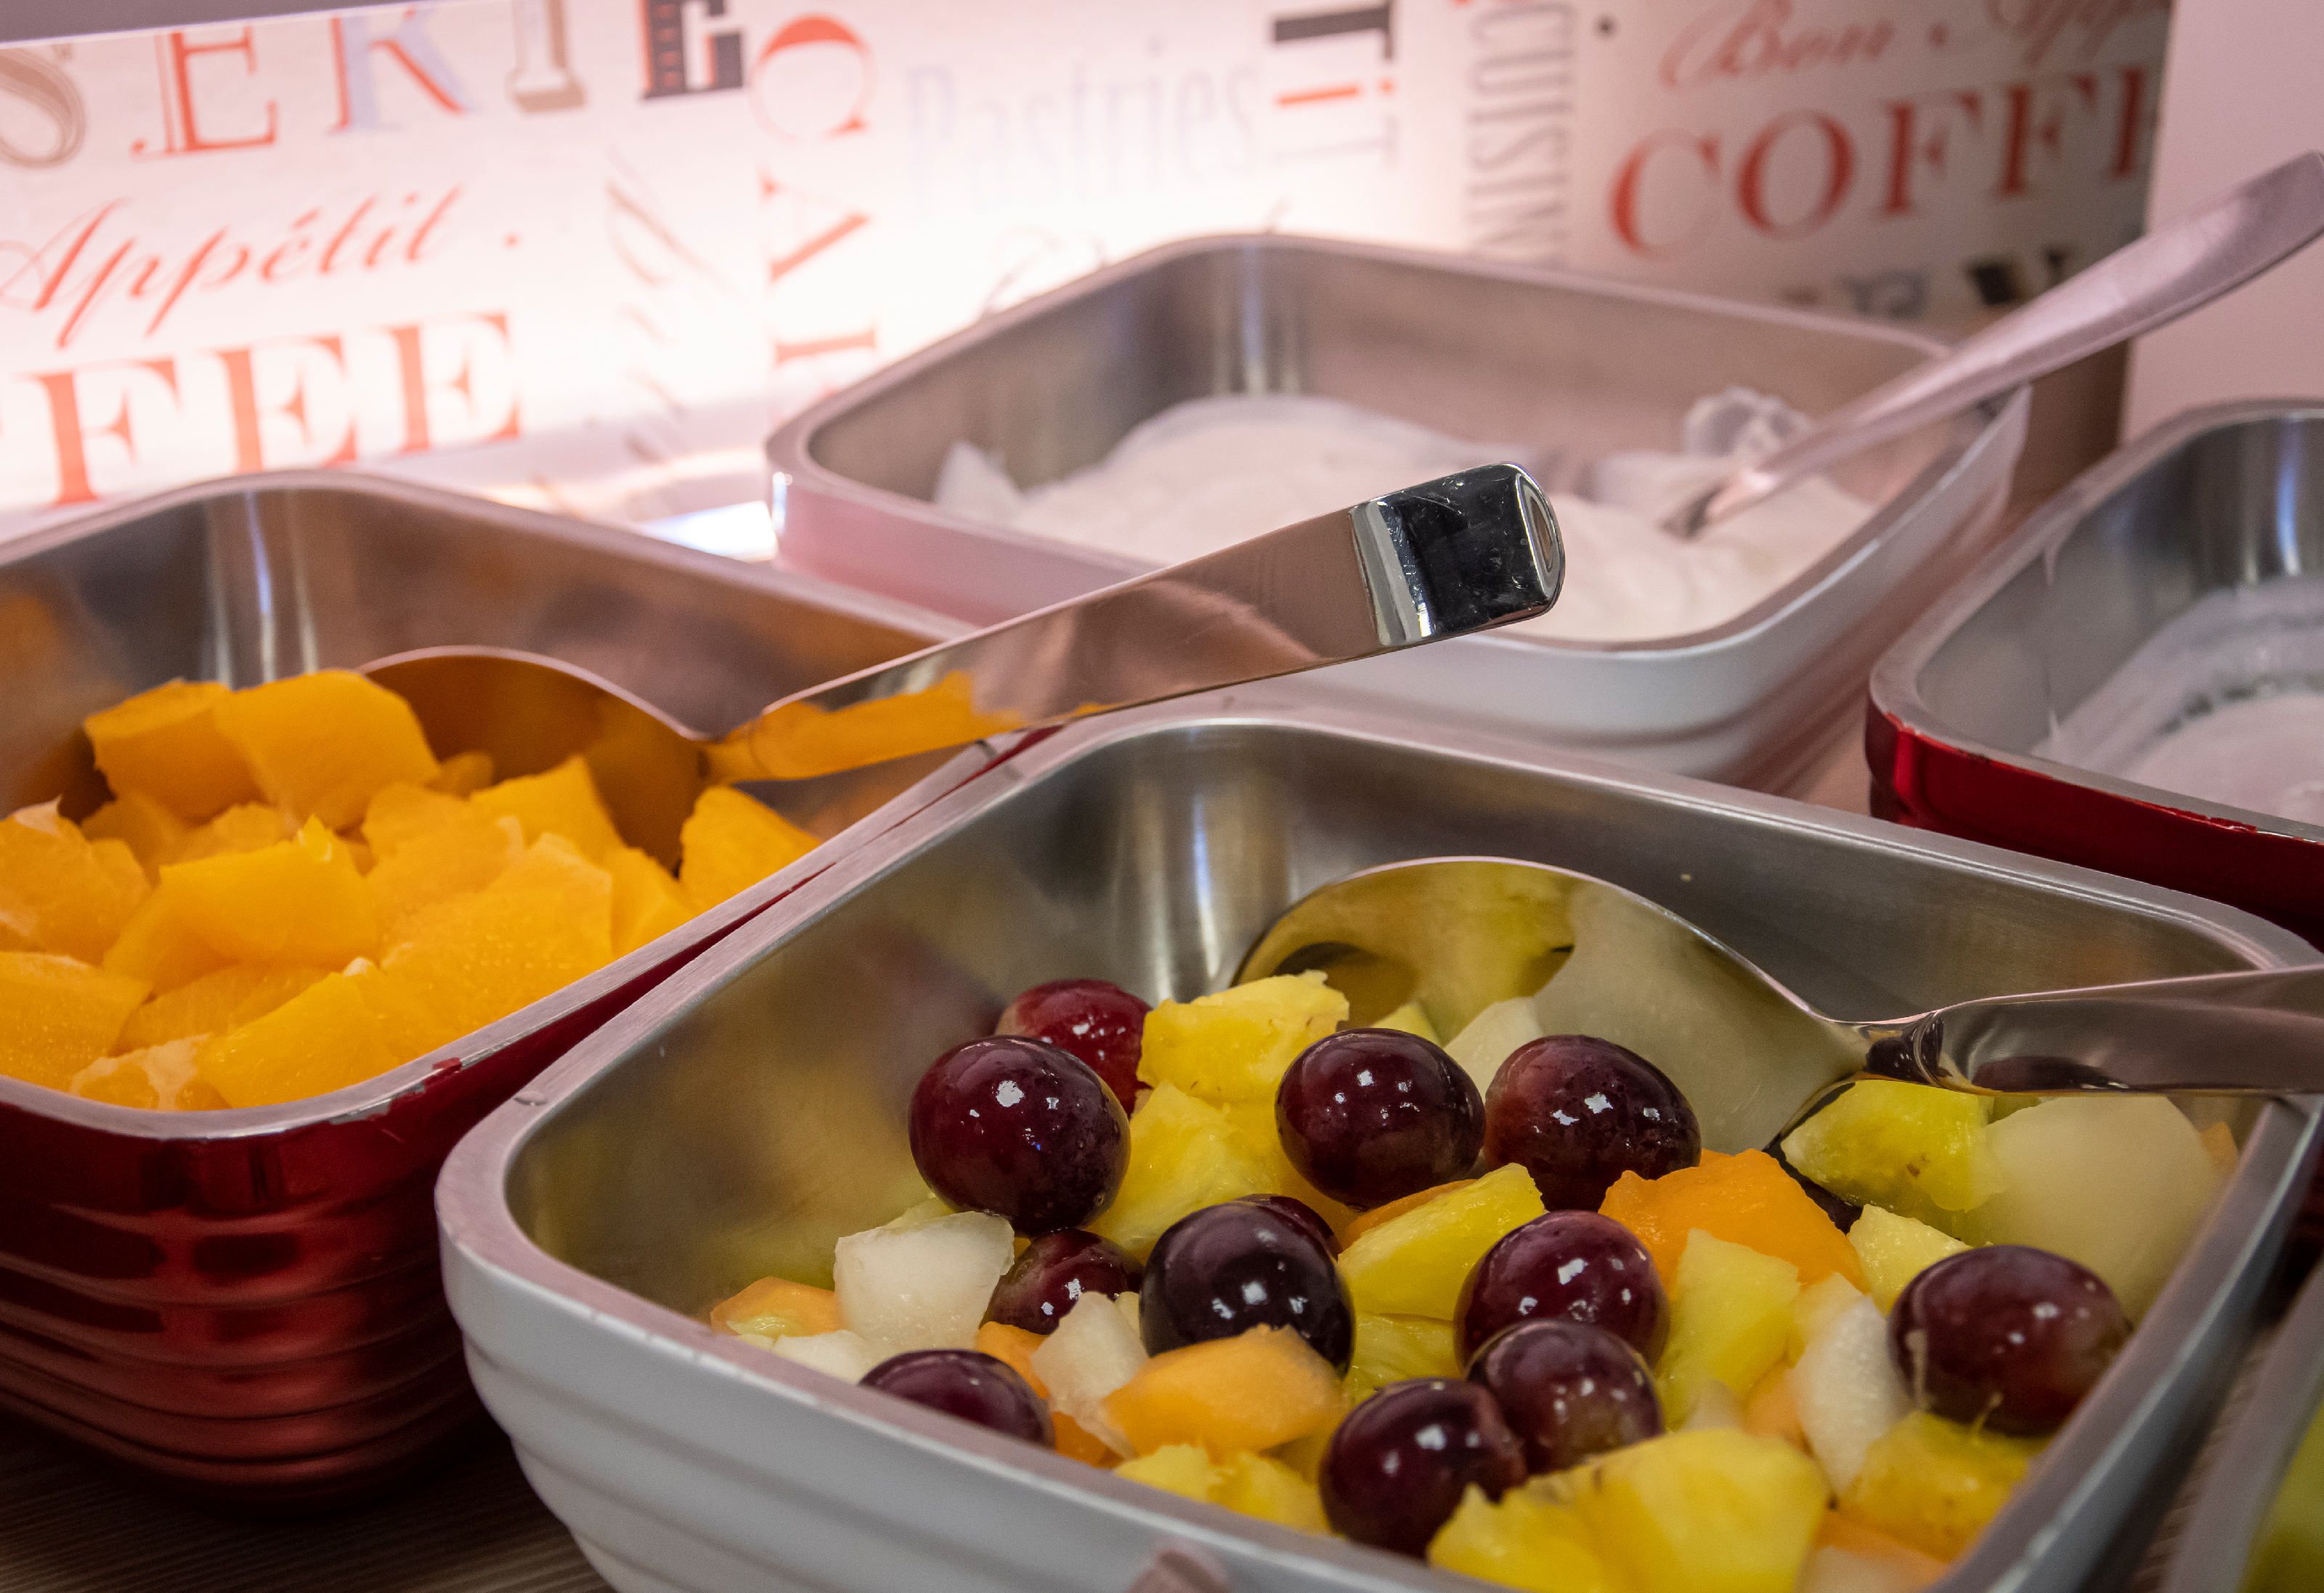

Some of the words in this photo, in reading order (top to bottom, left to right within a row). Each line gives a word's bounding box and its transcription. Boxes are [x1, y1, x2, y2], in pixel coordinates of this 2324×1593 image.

[902, 32, 1262, 219] Pastries
[1463, 1, 1577, 269] CUISIN
[0, 182, 465, 351] Appétit
[0, 311, 523, 507] FEE
